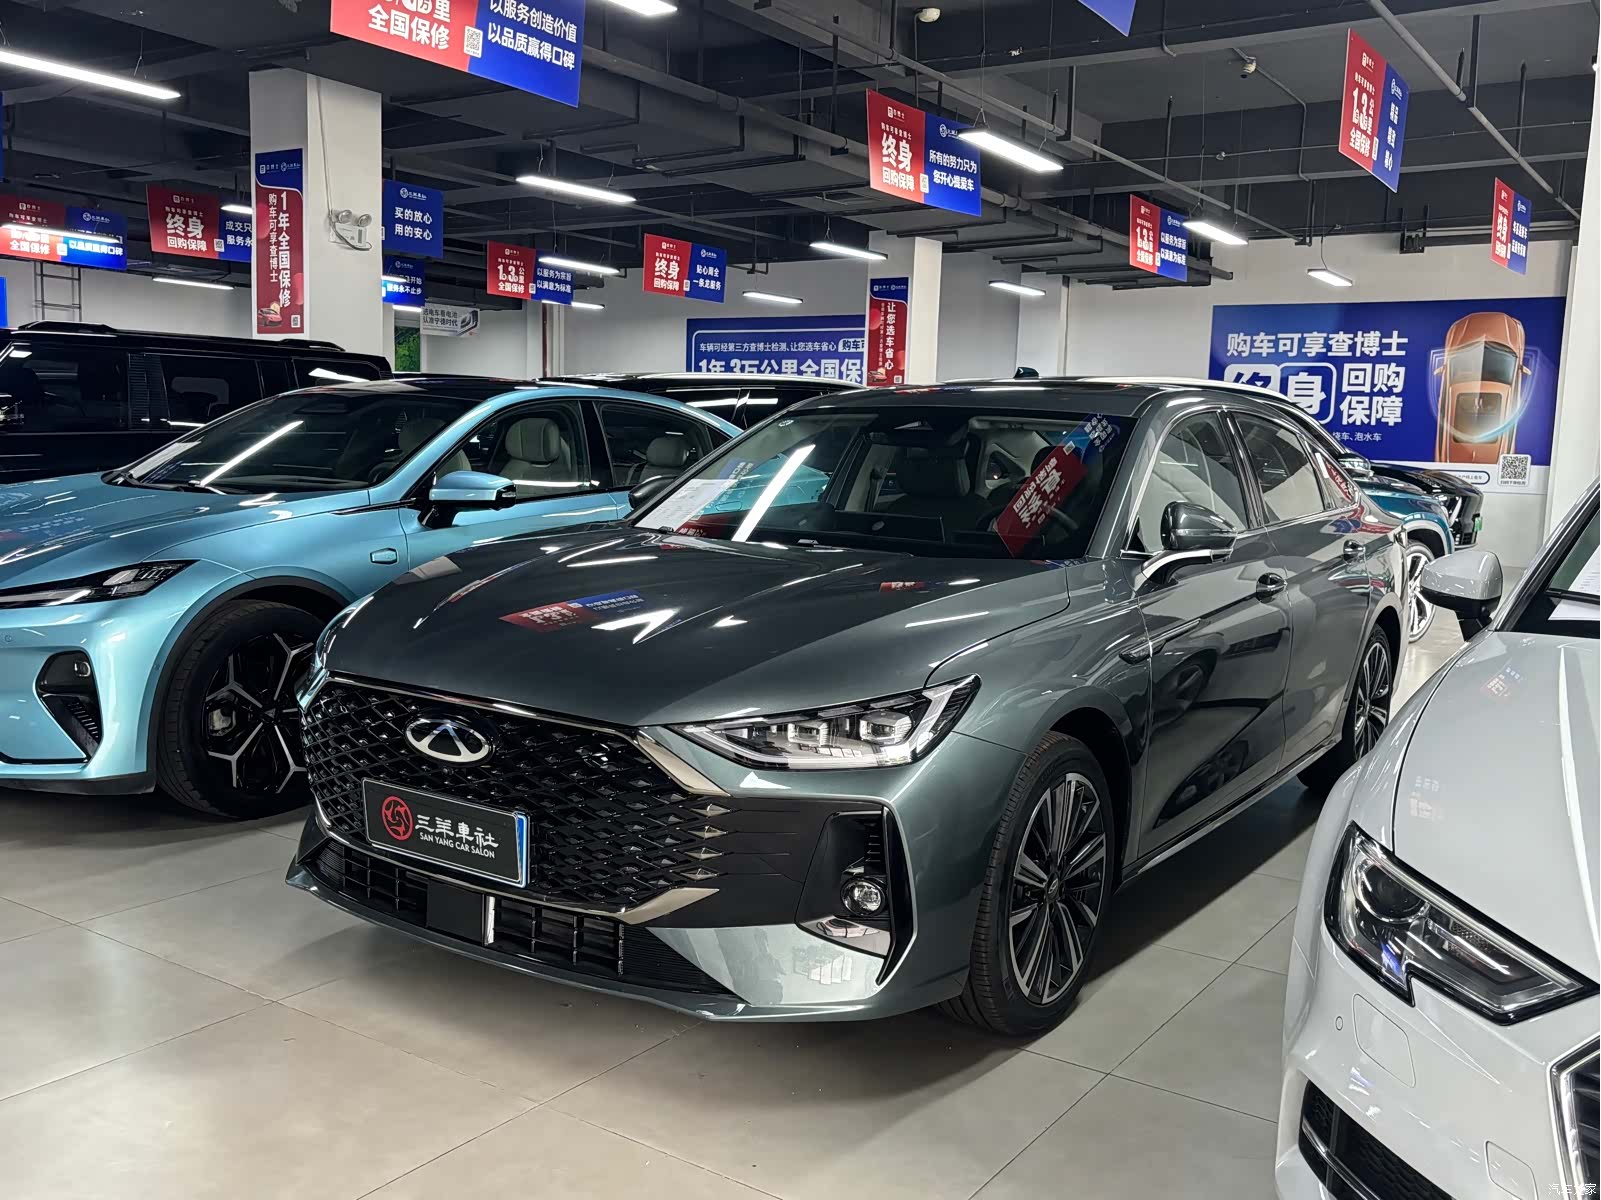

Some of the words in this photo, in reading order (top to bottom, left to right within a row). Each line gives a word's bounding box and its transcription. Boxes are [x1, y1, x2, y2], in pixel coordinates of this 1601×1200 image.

[368, 4, 449, 50] 全国保修
[490, 0, 577, 43] 以服务创造价值
[488, 22, 575, 70] 以品质赢得口碑
[881, 132, 913, 173] 终身
[929, 149, 978, 174] 所有的努力只为
[882, 166, 915, 192] 回购保障
[166, 213, 204, 238] 终身
[395, 207, 432, 224] 买的放心
[167, 236, 207, 252] 回购保障
[268, 193, 278, 282] 购车可享查博士
[395, 223, 432, 240] 用的安心
[278, 191, 291, 307] 1年全国保修
[654, 257, 680, 280] 终身
[498, 281, 525, 294] 全国保修
[693, 278, 722, 291] 一条龙服务
[885, 302, 896, 370] 让您选车省心
[1226, 330, 1409, 357] 购车可享查博士
[1341, 362, 1406, 393] 回购
[1339, 395, 1403, 426] 保障
[415, 814, 499, 848] 三羊車社
[419, 832, 435, 842] SAN
[435, 836, 454, 848] YANG
[455, 842, 471, 853] CAR
[471, 845, 496, 859] SALON
